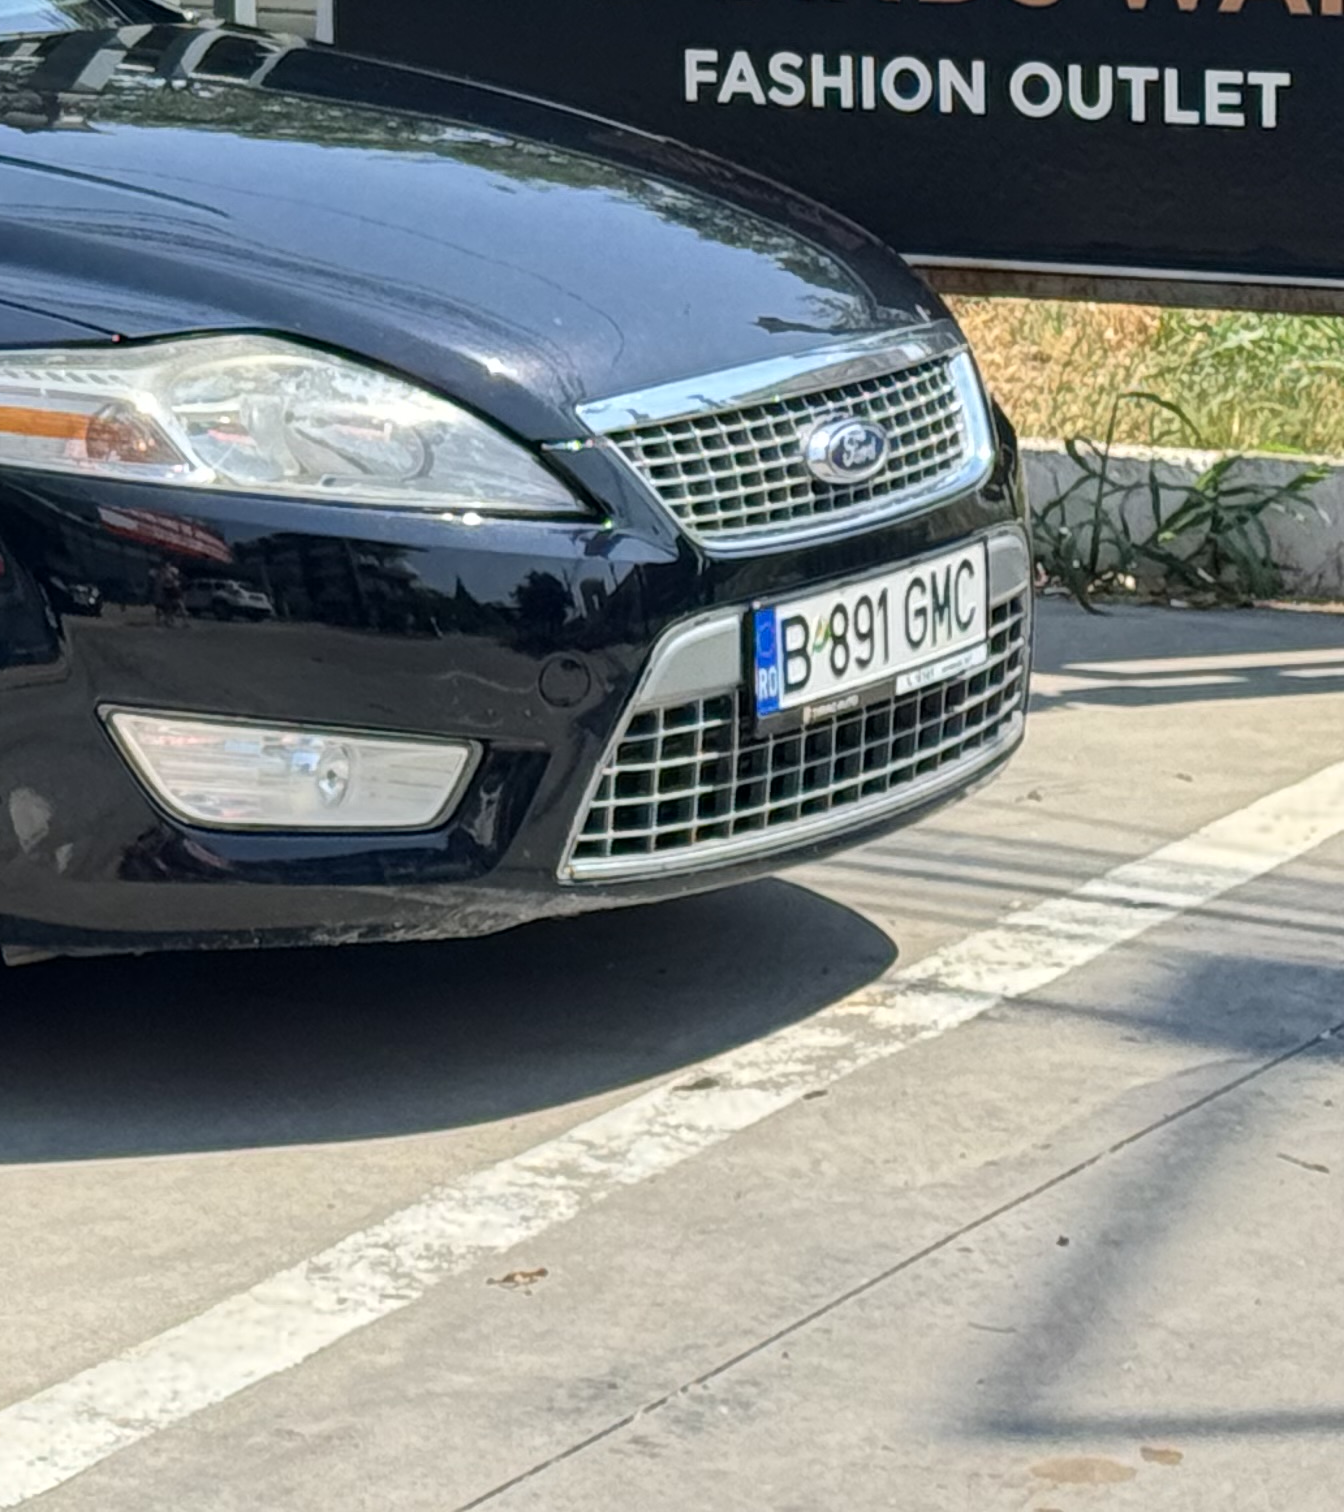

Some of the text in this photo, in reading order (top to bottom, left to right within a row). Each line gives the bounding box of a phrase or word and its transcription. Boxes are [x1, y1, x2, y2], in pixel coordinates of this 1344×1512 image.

[683, 48, 1292, 128] FASHION OUTLET
[780, 558, 976, 695] B 891 GMC
[757, 667, 778, 702] RO
